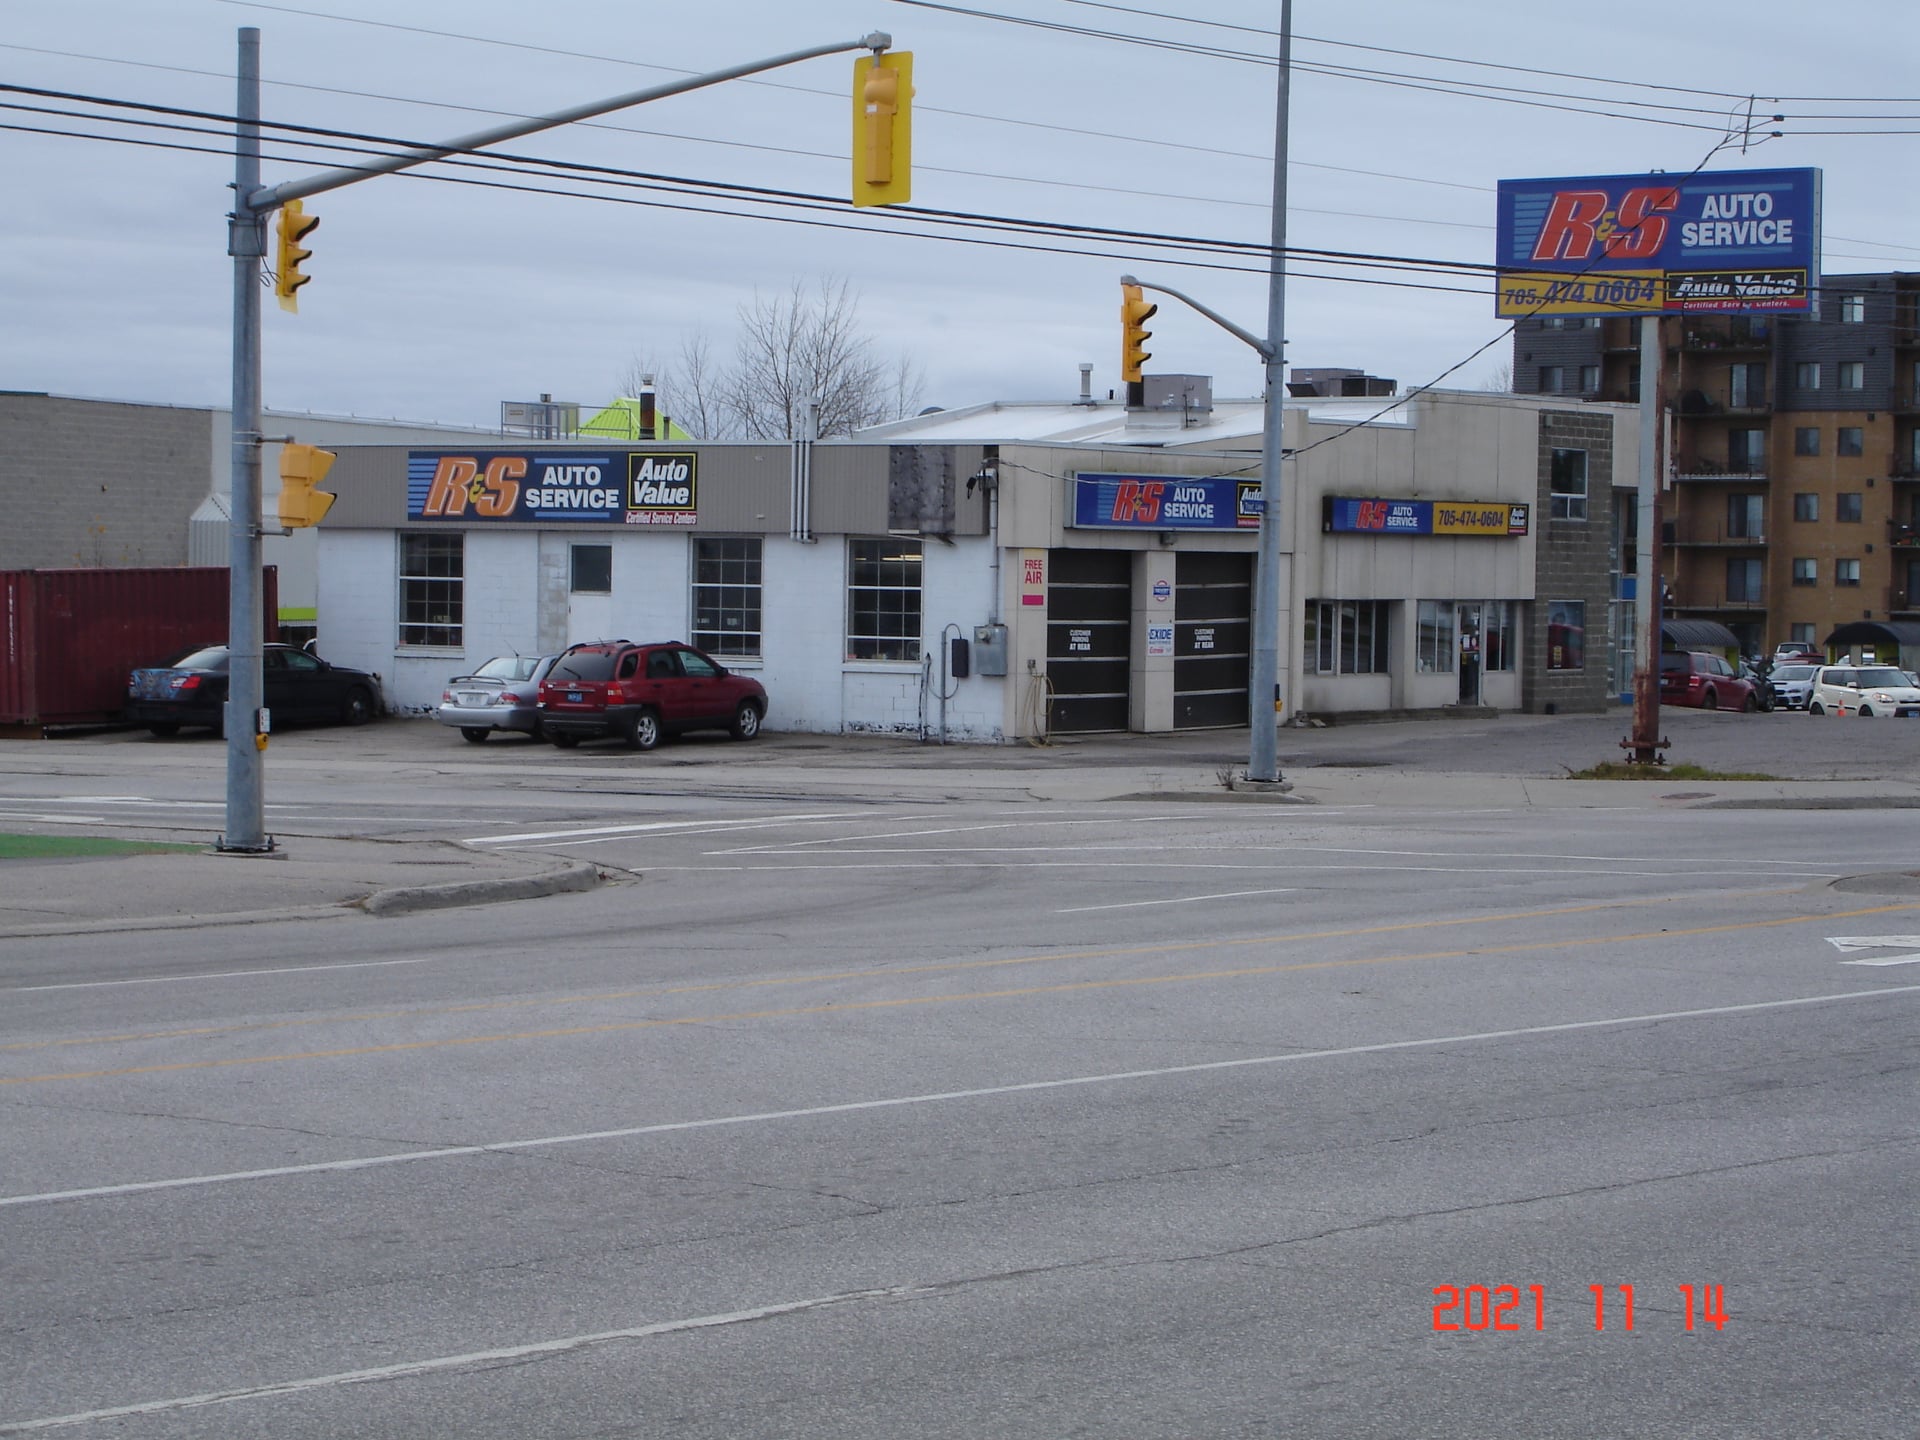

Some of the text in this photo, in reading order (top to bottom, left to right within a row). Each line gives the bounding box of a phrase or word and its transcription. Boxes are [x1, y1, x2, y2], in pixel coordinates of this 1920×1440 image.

[1702, 193, 1773, 219] AUTO
[1532, 186, 1681, 261] R&S
[1681, 219, 1793, 247] SERVICE
[1734, 273, 1798, 296] Value
[542, 466, 601, 486] AUTO
[636, 458, 688, 481] Auto
[423, 457, 528, 516] R&S
[633, 481, 689, 504] Value
[1173, 487, 1206, 502] AUTO
[525, 488, 619, 508] SERVICE
[651, 512, 673, 524] Service
[1164, 500, 1214, 519] SERVICE
[1392, 506, 1413, 517] AUTO
[1438, 510, 1504, 527] 705-474-0604
[1386, 516, 1418, 527] SERVICE
[1024, 559, 1043, 570] FREE
[1024, 571, 1042, 584] AIR
[1149, 628, 1173, 640] EXIDE
